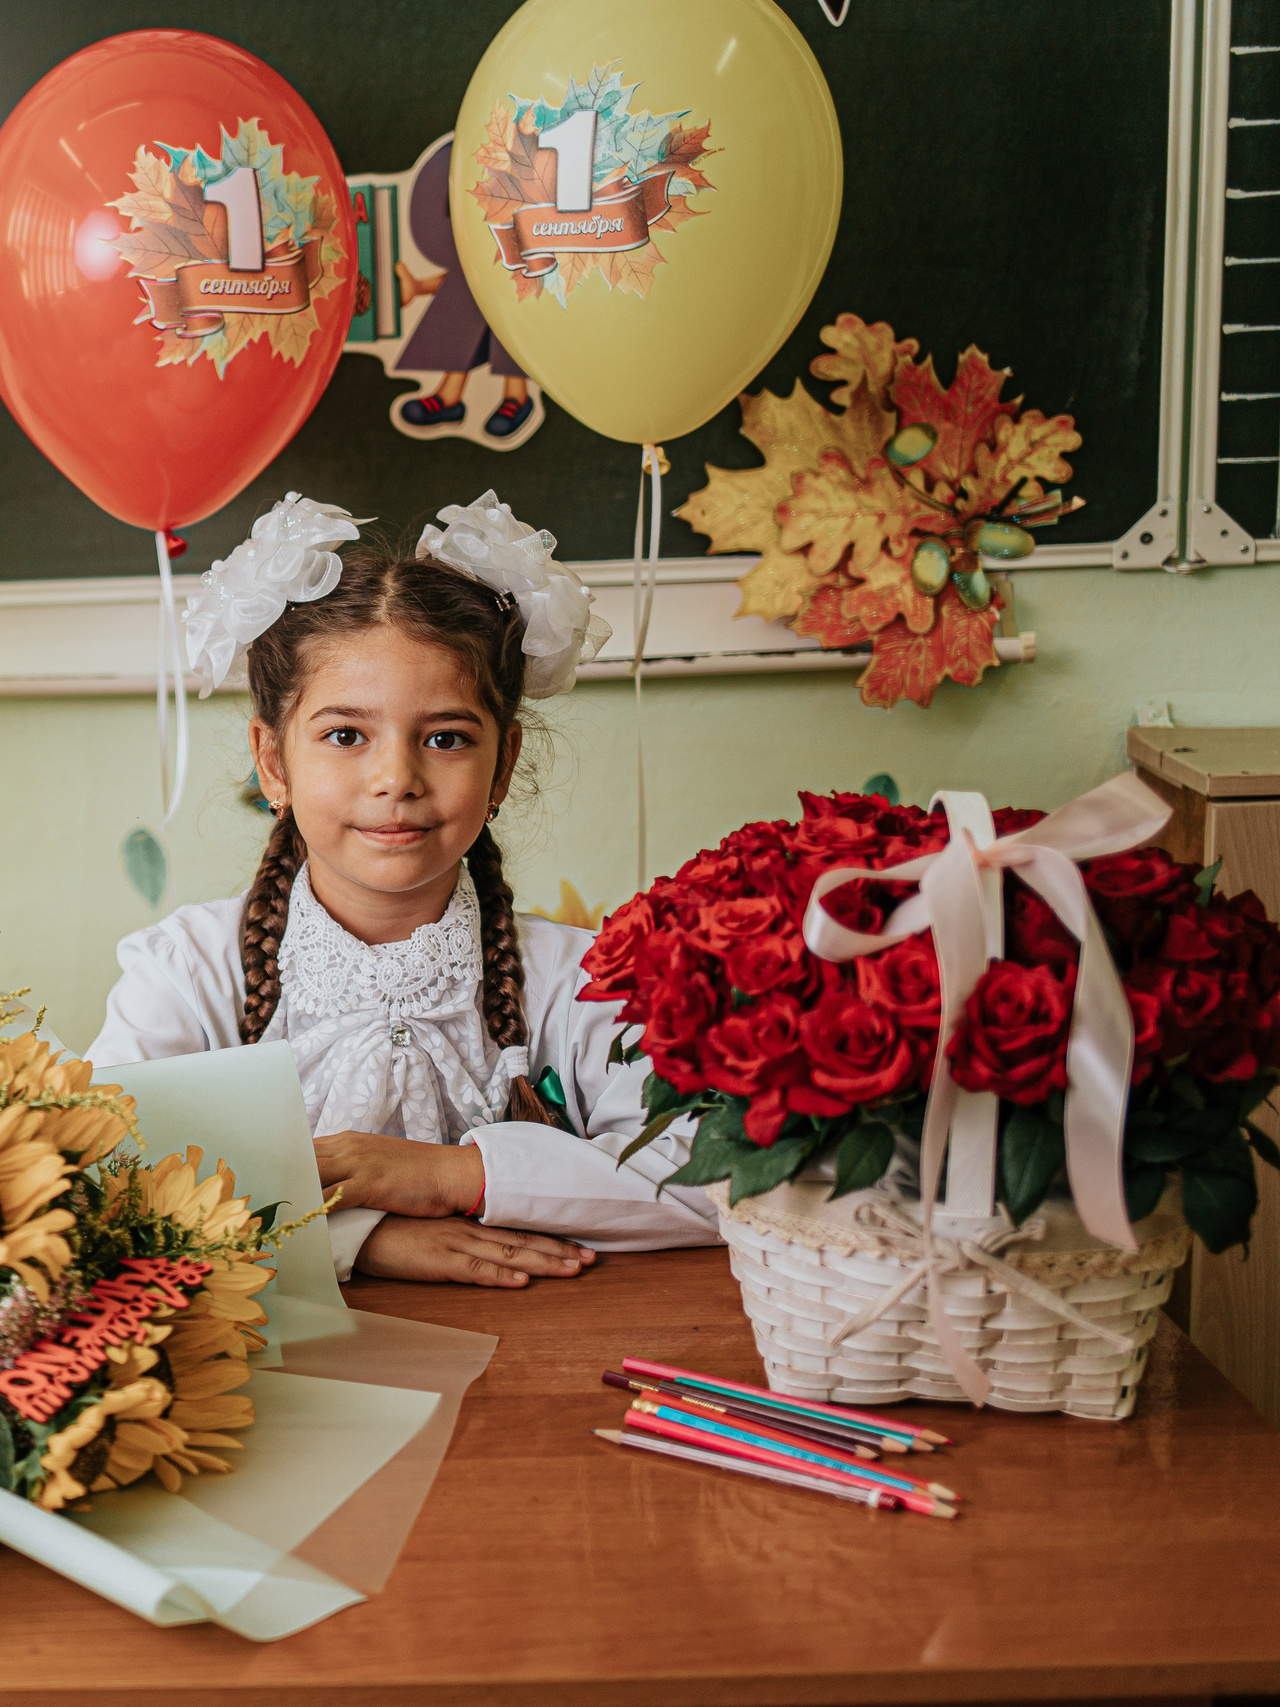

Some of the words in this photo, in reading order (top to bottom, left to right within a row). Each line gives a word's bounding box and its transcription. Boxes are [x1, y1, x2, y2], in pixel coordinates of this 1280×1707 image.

[538, 109, 598, 212] 1
[204, 167, 264, 271] 1
[532, 214, 624, 239] сентября
[199, 276, 291, 300] сентября
